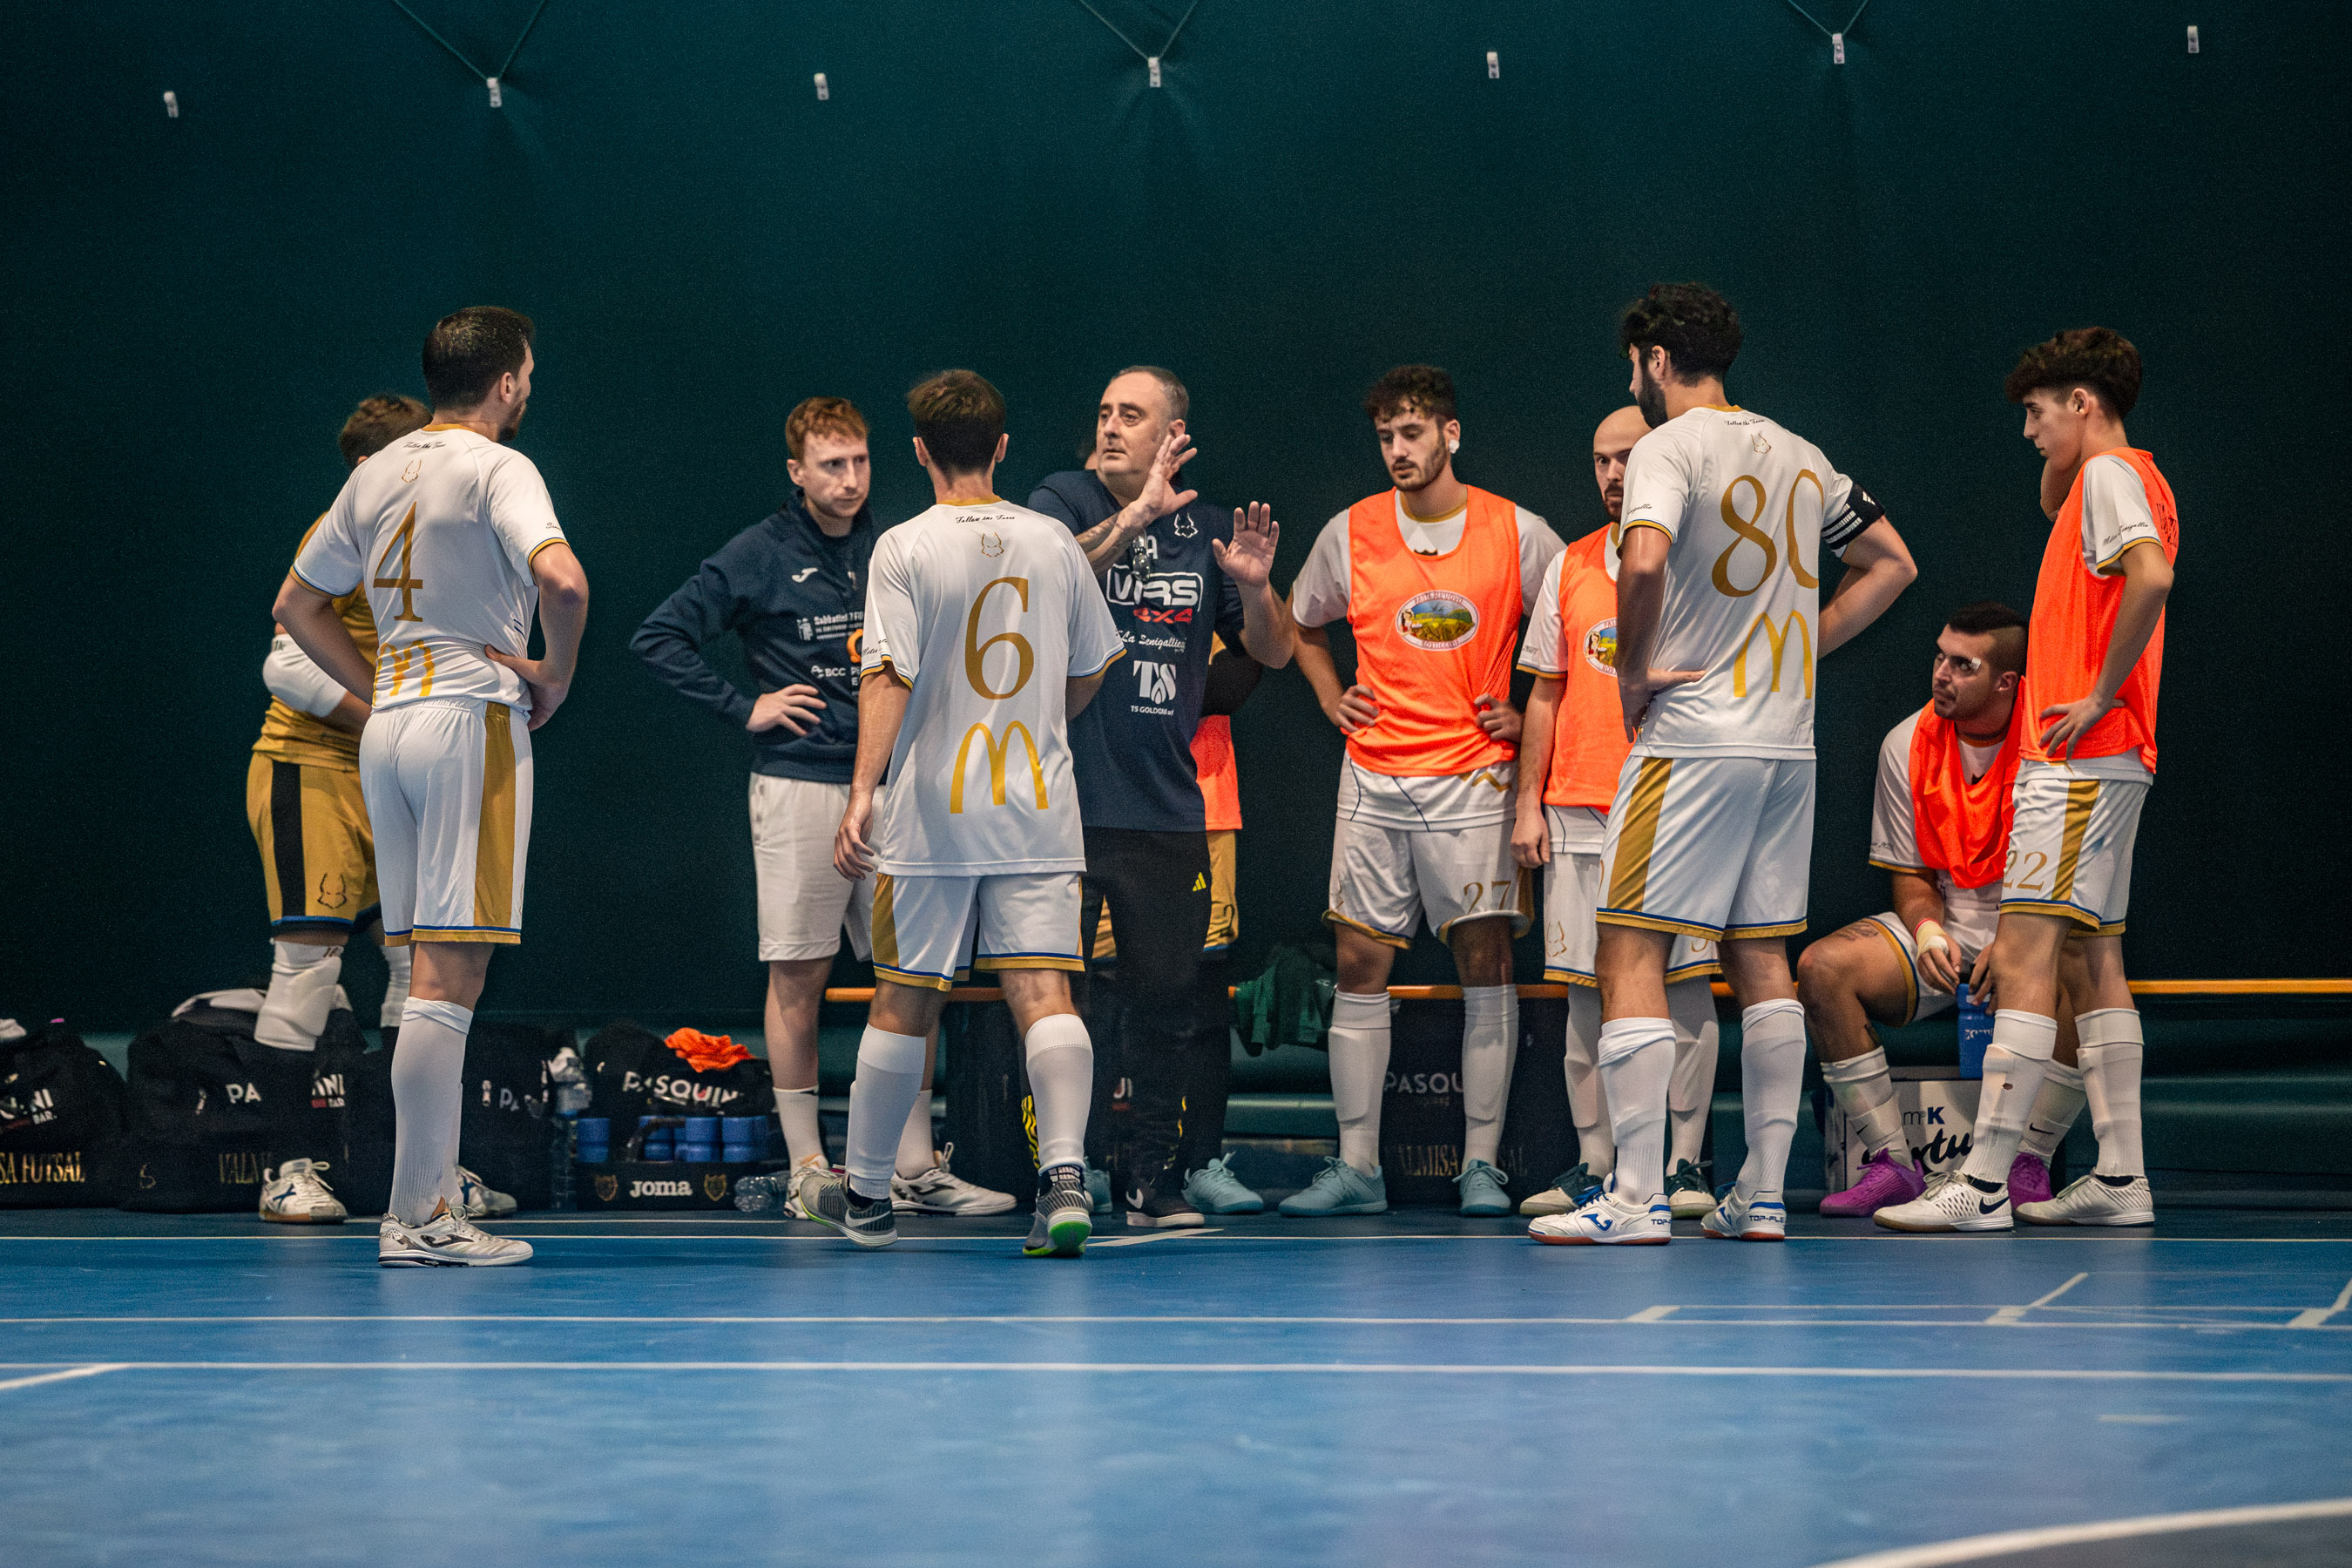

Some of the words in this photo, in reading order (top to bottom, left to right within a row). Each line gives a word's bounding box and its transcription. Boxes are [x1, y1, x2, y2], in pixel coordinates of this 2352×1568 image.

[373, 501, 423, 622] 4
[964, 576, 1035, 700] 6
[1463, 880, 1511, 916] 27
